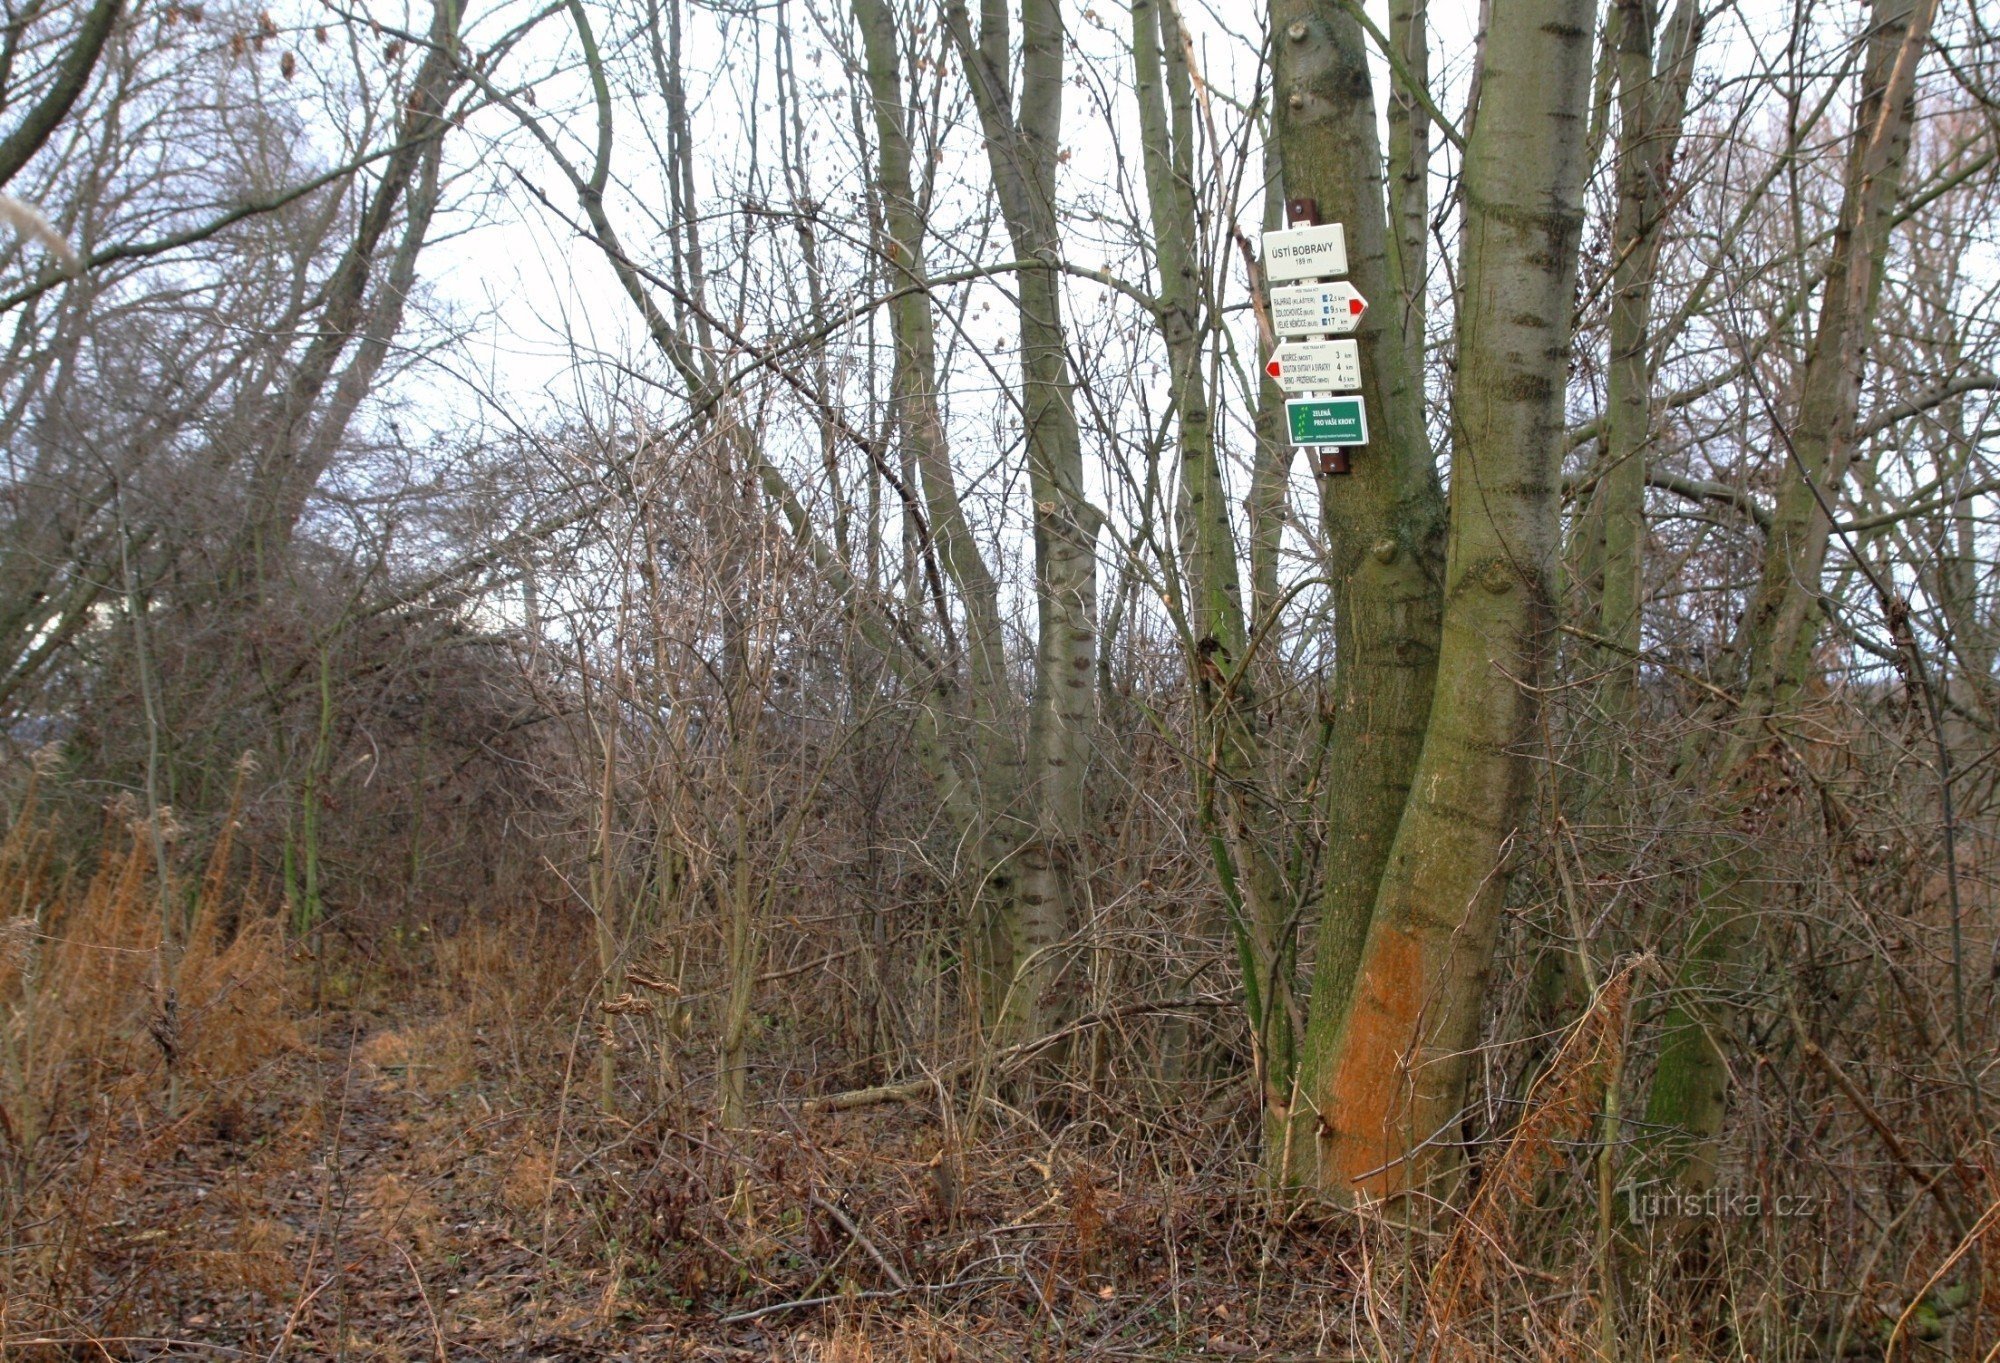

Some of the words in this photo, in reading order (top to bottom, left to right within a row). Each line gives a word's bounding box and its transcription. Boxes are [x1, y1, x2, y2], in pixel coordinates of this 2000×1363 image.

[1272, 245, 1290, 259] ÚSTÍ
[1293, 242, 1333, 256] BOBRAVY
[1328, 318, 1335, 326] 17
[1336, 351, 1340, 359] 3
[1336, 362, 1342, 371] 4
[1312, 408, 1331, 417] ZELENÁ
[1324, 418, 1337, 426] VAŠE
